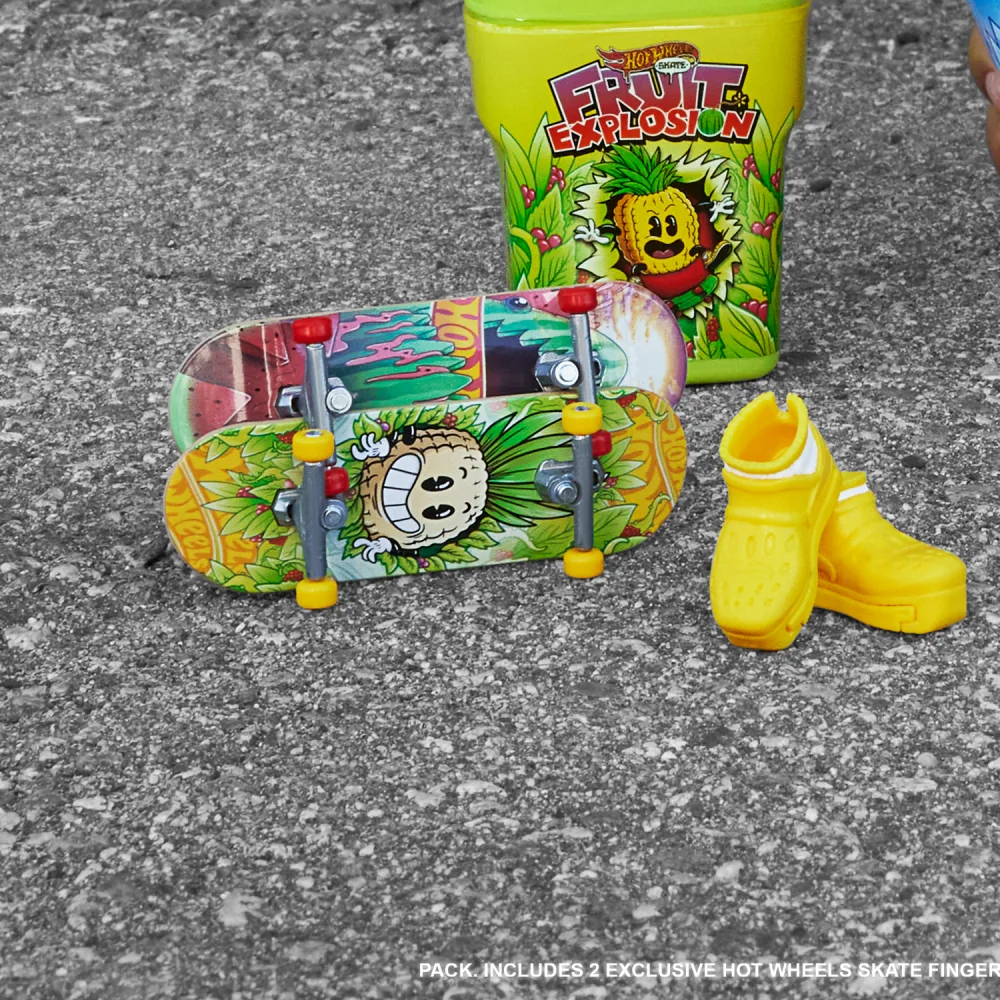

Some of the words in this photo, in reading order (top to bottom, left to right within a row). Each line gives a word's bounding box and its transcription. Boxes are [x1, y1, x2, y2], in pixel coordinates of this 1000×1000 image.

[622, 51, 651, 70] HOT
[650, 43, 693, 64] WHEEL
[657, 60, 688, 70] SKATE
[548, 60, 747, 123] FRUIT
[545, 106, 760, 157] EXPLOSION
